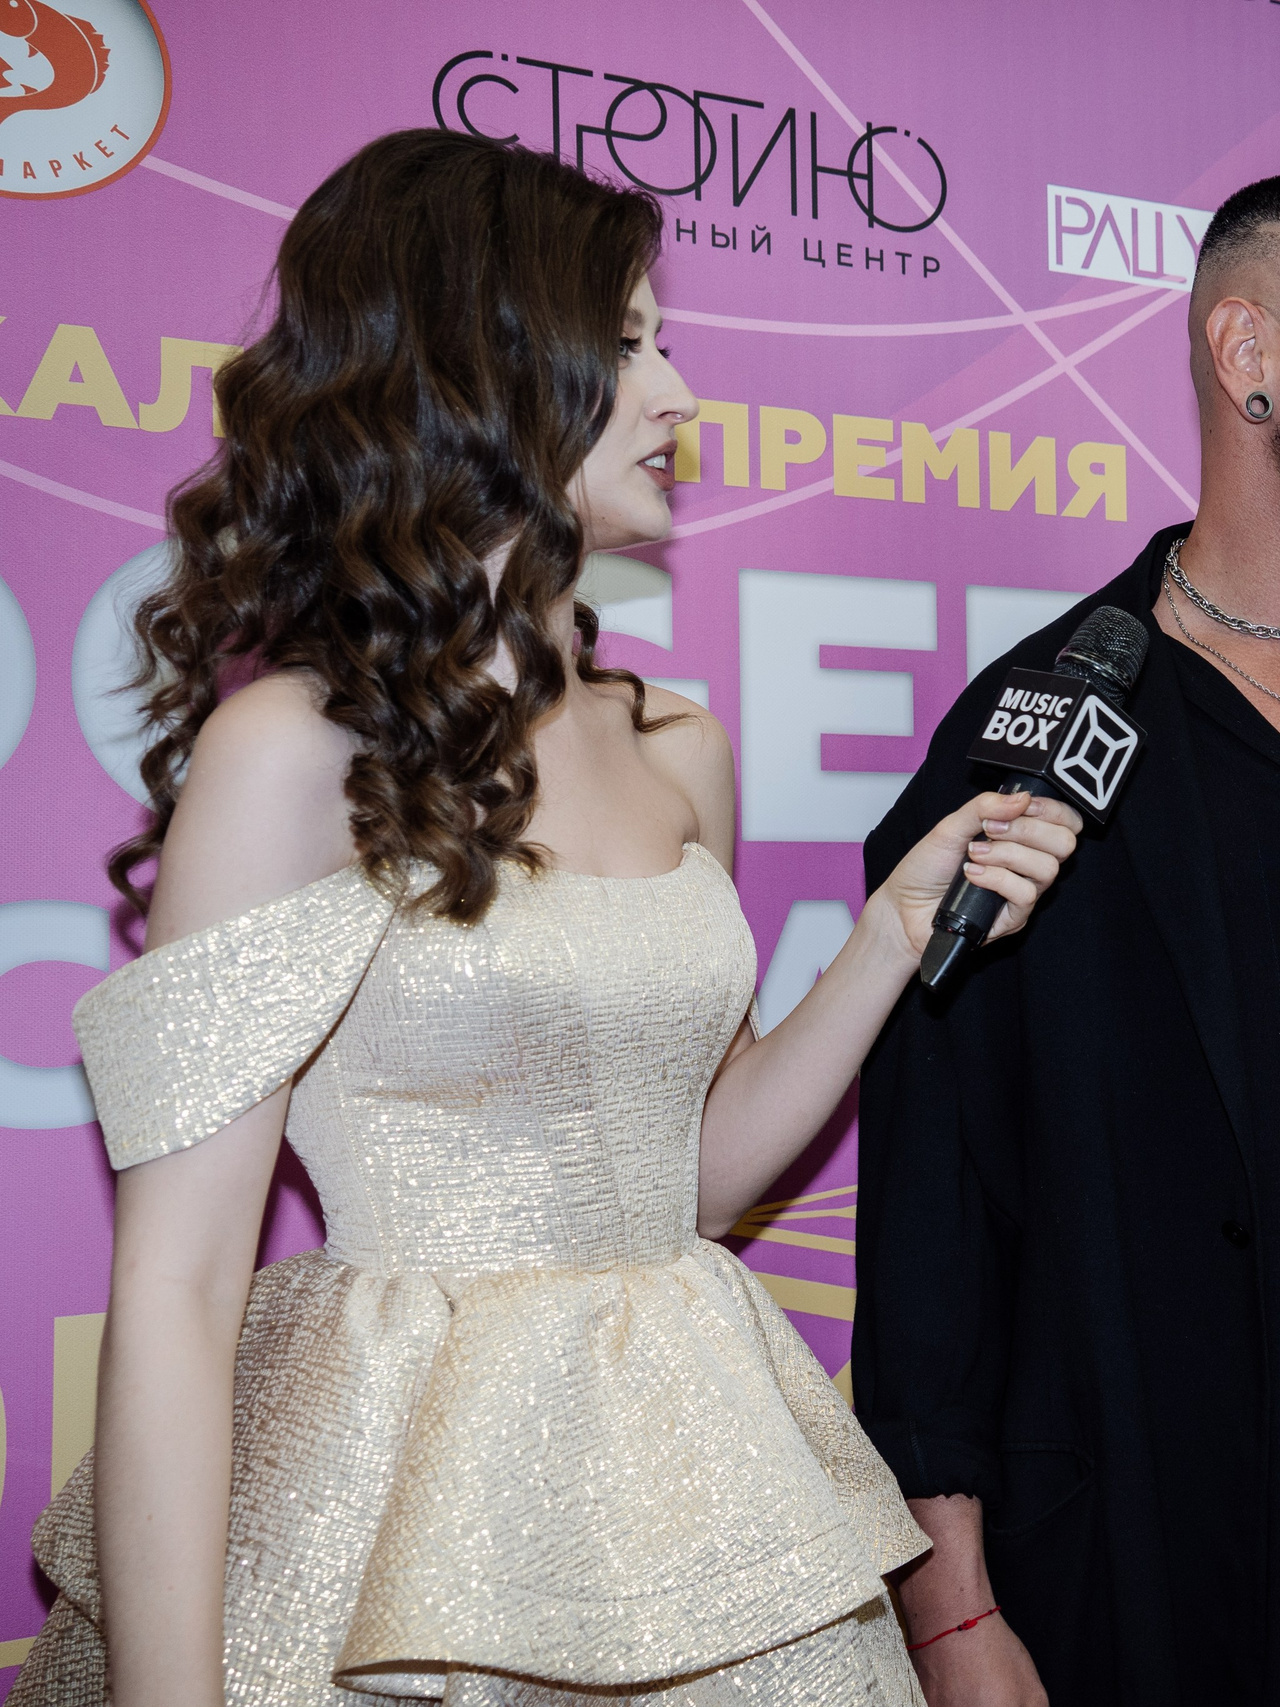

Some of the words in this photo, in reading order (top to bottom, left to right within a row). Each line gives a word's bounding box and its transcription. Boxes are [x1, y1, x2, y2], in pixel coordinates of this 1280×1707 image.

[803, 238, 940, 278] ЦЕНТР
[675, 398, 1129, 523] ПРЕМИЯ
[998, 687, 1073, 718] MUSIC
[982, 710, 1060, 750] BOX
